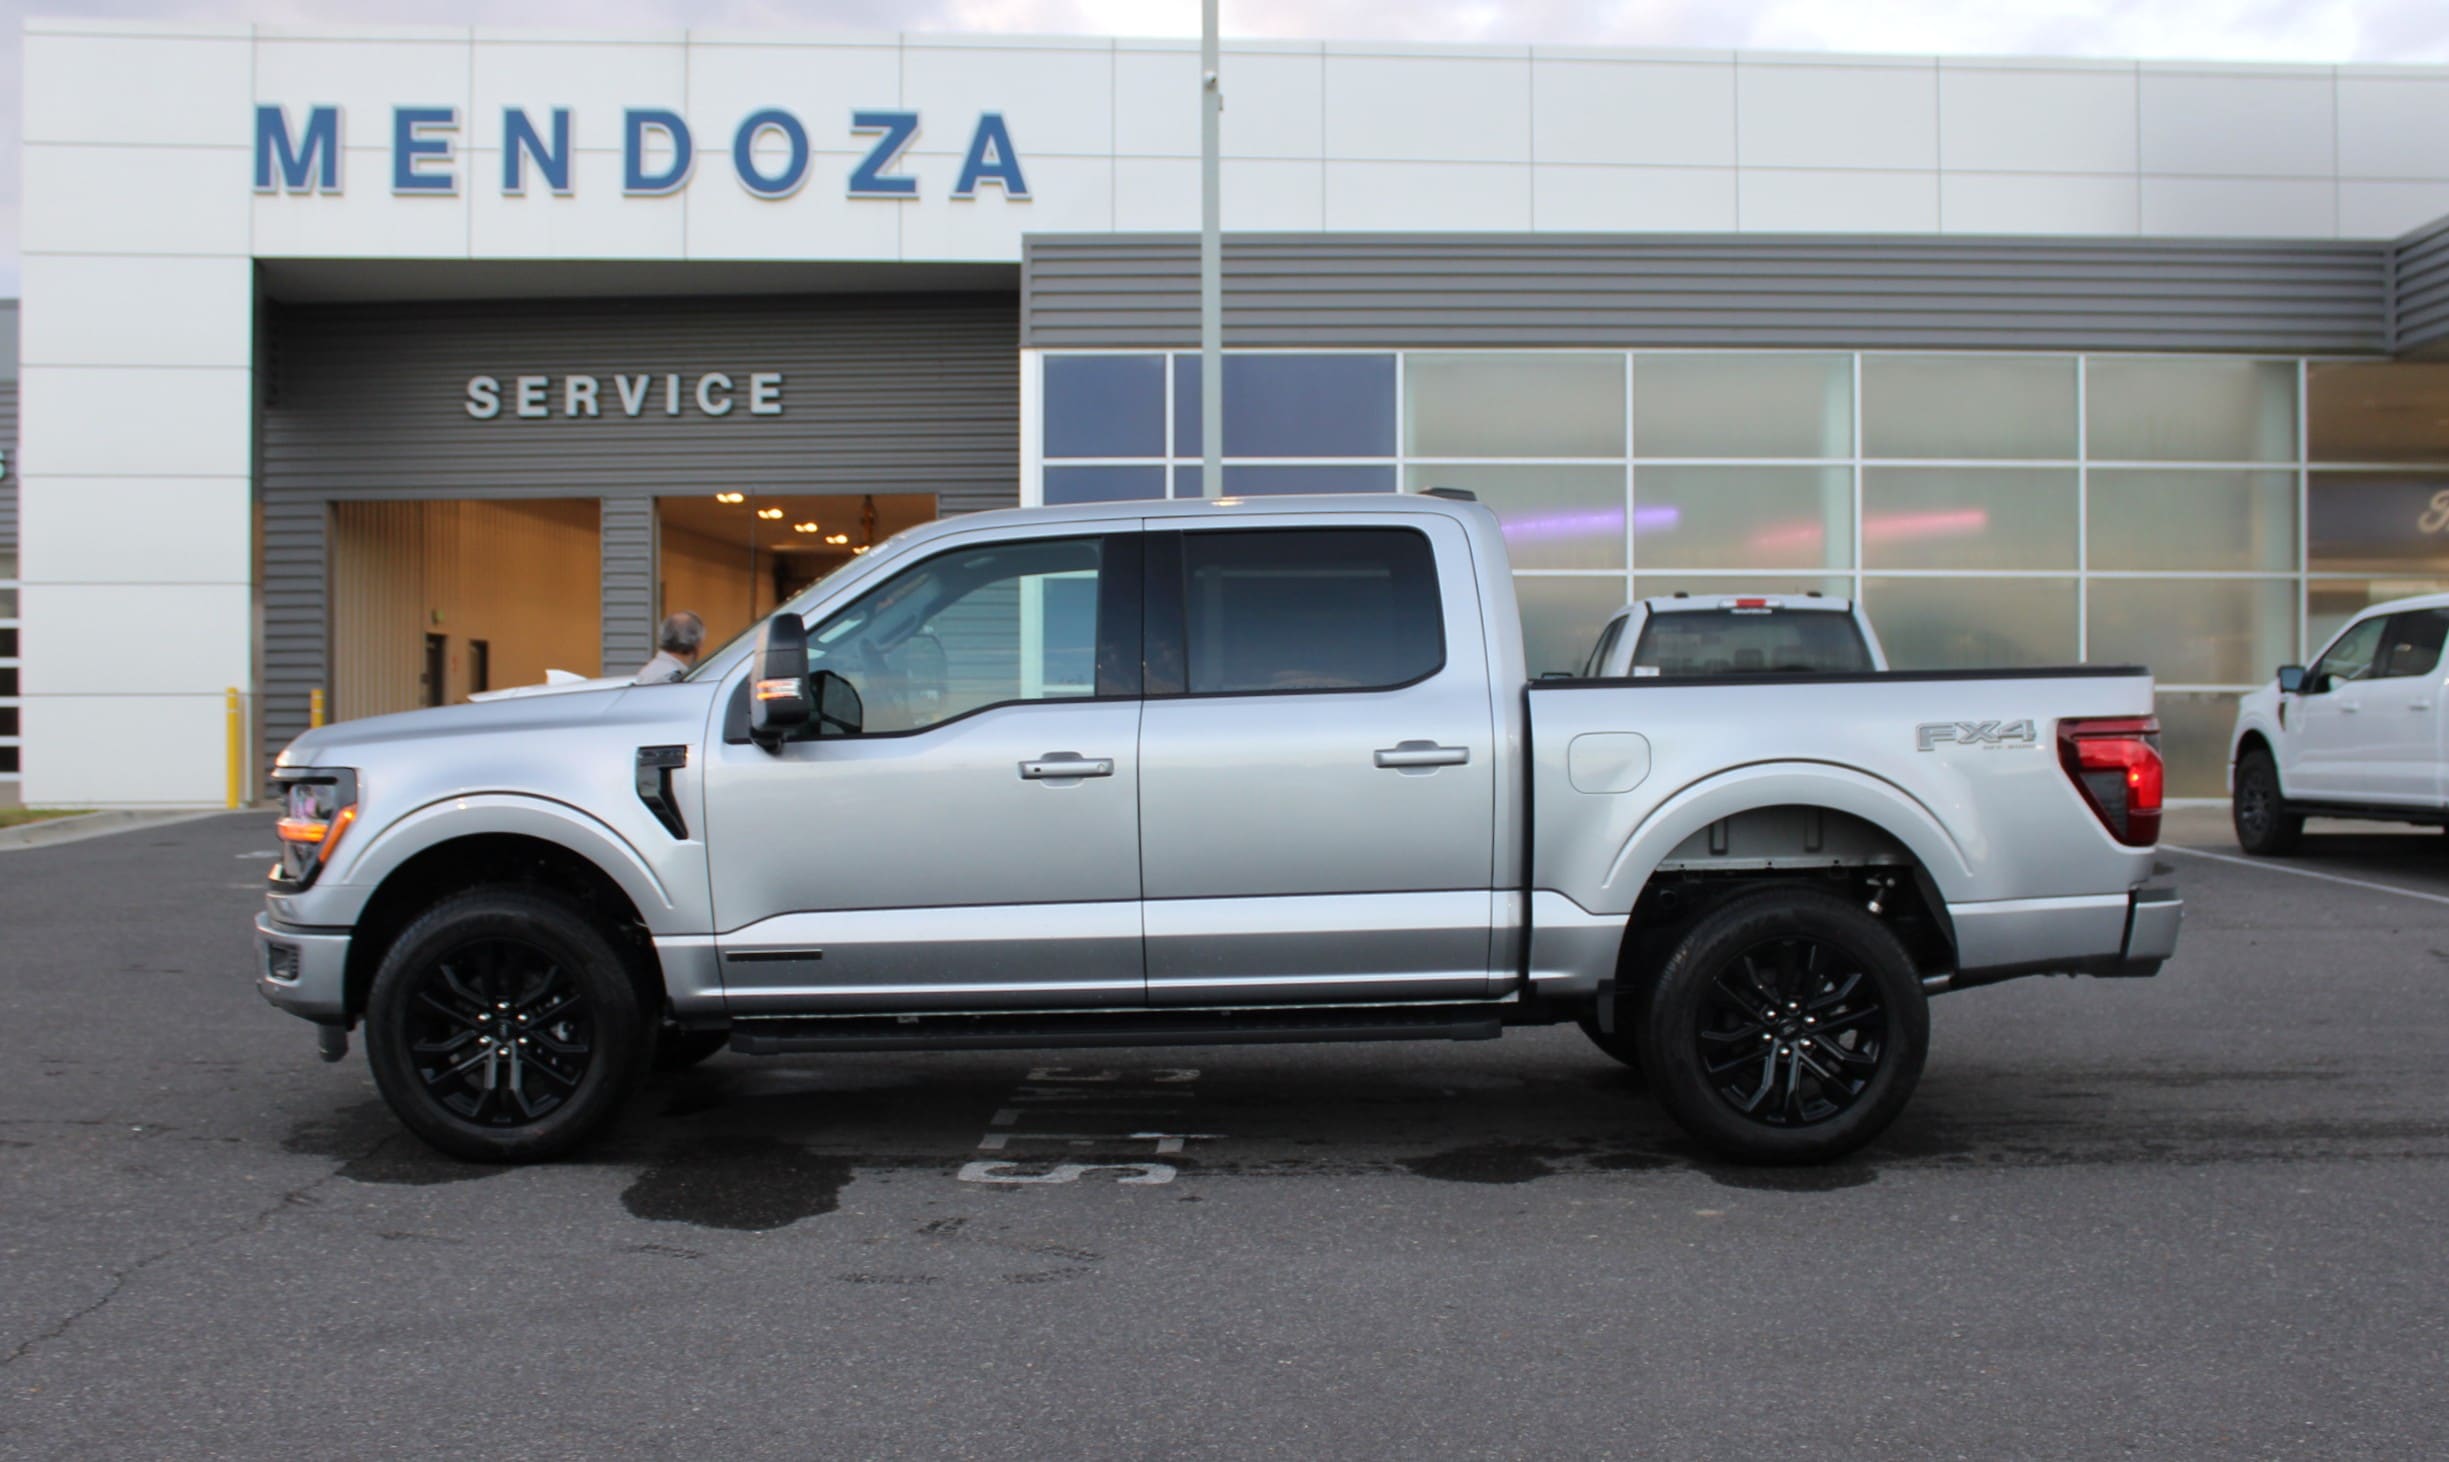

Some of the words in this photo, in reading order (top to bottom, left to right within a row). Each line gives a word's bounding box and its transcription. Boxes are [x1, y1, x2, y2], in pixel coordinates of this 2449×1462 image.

[253, 104, 1032, 200] MENDOZA
[464, 371, 784, 419] SERVICE
[1916, 719, 2036, 752] FX4
